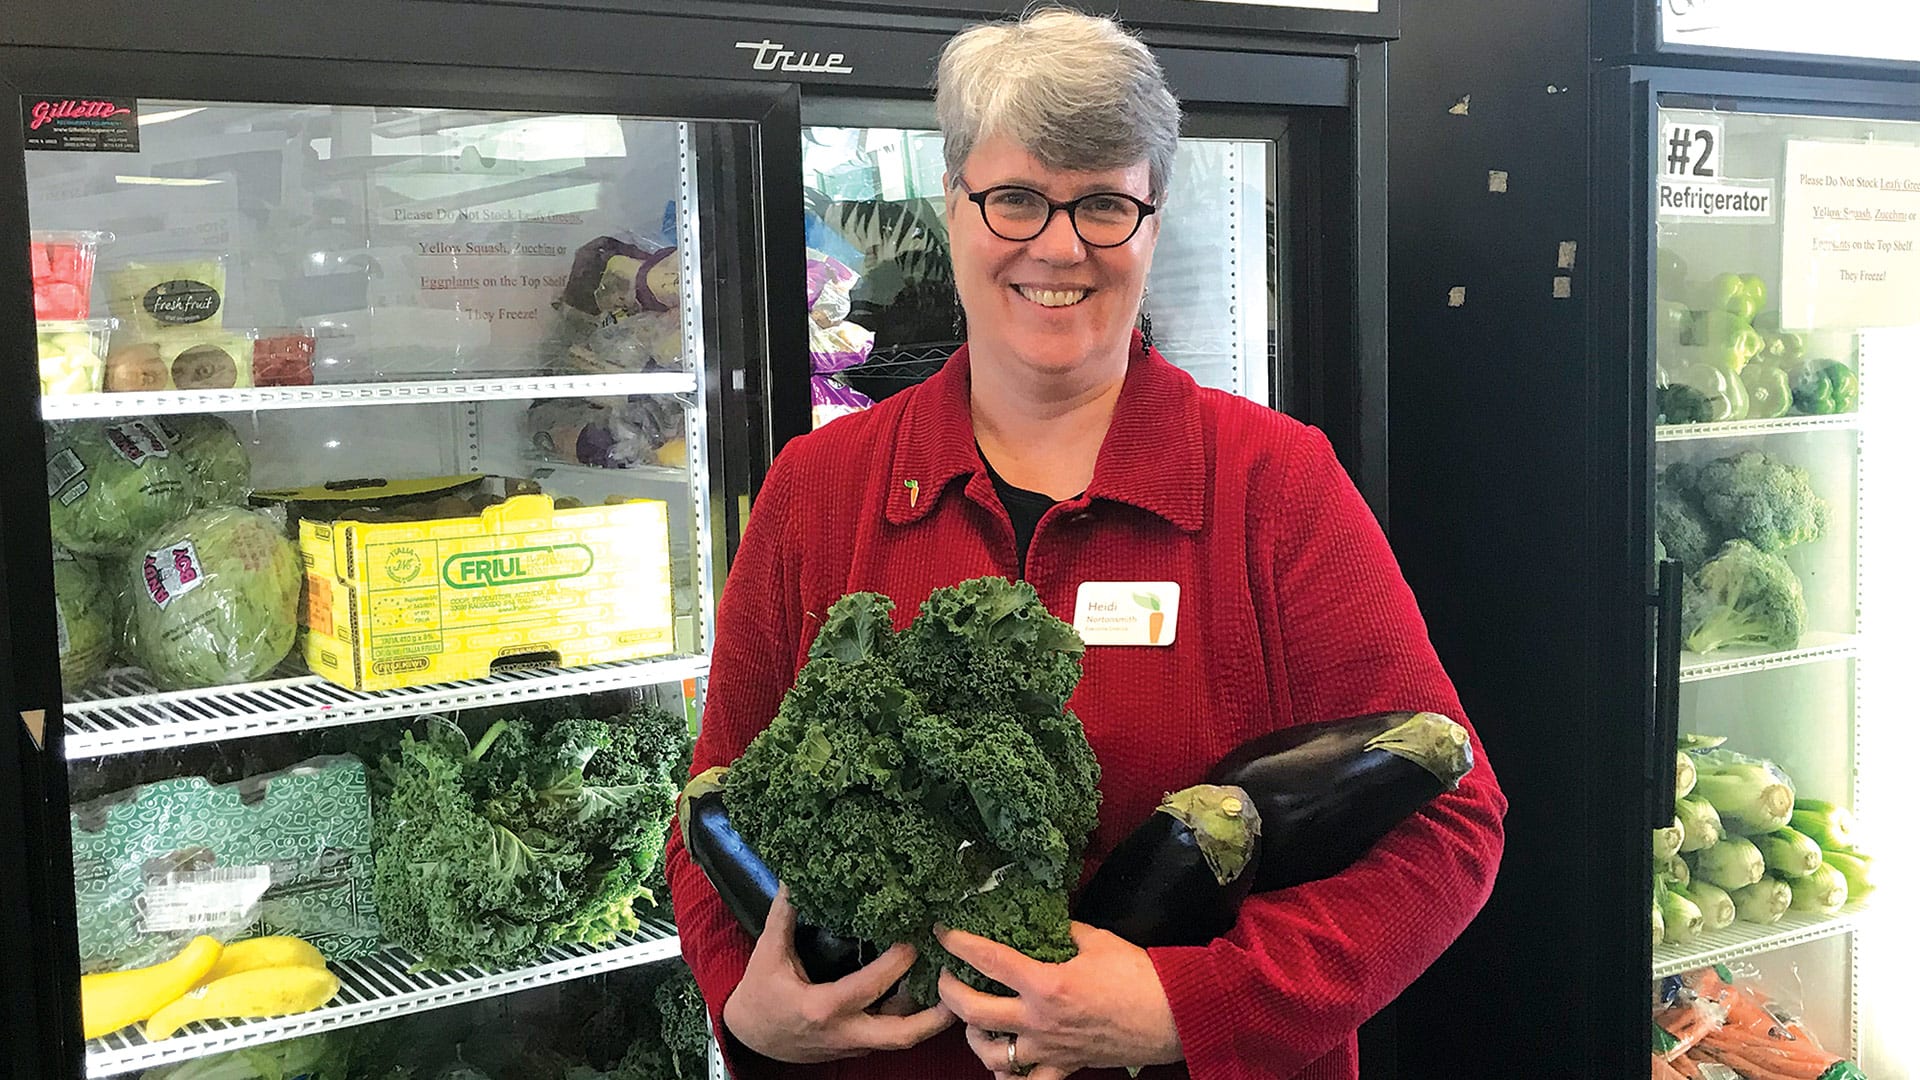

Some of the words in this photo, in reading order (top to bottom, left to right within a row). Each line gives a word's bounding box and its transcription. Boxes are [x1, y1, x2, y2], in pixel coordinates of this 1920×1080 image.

[735, 40, 853, 74] true
[30, 99, 131, 131] Gillette
[1667, 127, 1714, 177] #2
[1800, 174, 1824, 186] Please
[1825, 175, 1838, 187] Do
[1839, 176, 1855, 188] Not
[1856, 177, 1879, 188] Stock
[1880, 178, 1901, 190] Leafy
[1660, 185, 1768, 215] Refrigerator
[393, 208, 433, 221] Please
[437, 208, 455, 220] Do
[459, 208, 480, 221] Not
[484, 208, 514, 221] Stock
[1813, 206, 1841, 218] Yellow
[1908, 212, 1917, 221] or
[418, 242, 461, 255] Yellow
[465, 242, 510, 255] Squash,
[514, 242, 556, 255] Zucchini
[557, 246, 567, 255] or
[1852, 242, 1862, 250] on
[1863, 240, 1875, 250] the
[1877, 239, 1892, 253] Top
[420, 276, 480, 290] Eggplants
[482, 279, 497, 287] on
[499, 275, 518, 287] the
[520, 275, 541, 290] Top
[1840, 269, 1858, 283] They
[1859, 270, 1887, 281] Freeze!
[153, 296, 183, 313] fresh
[184, 296, 213, 312] fruit
[465, 308, 494, 323] They
[498, 307, 538, 320] Freeze!
[172, 547, 198, 585] BOY
[143, 553, 170, 604] ANDY
[1088, 601, 1118, 612] Heidi
